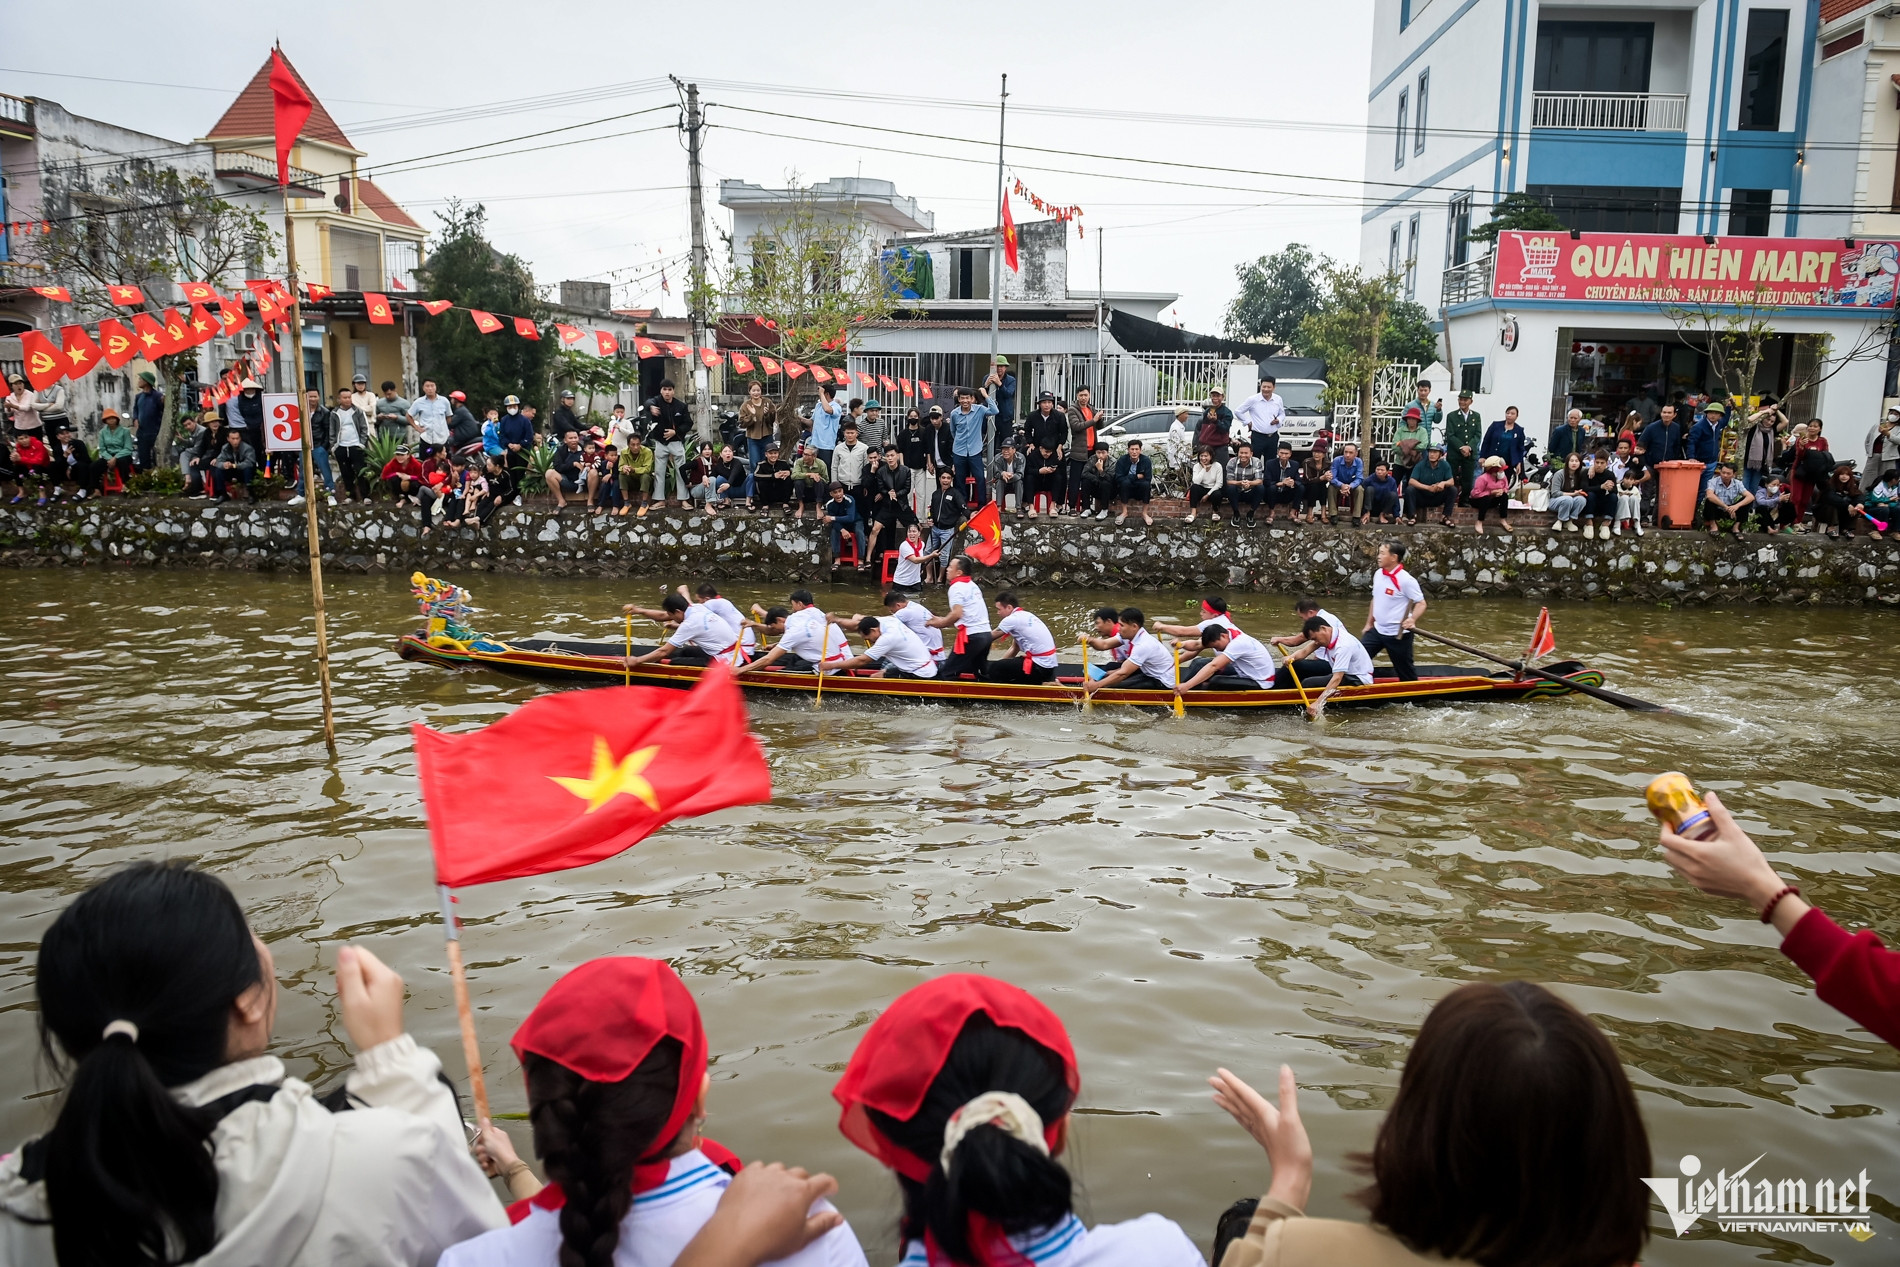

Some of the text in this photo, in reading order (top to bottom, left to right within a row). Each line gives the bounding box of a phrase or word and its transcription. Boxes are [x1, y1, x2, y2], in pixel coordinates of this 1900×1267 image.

[1570, 238, 1838, 284] QUÂN HIỀN MART
[1585, 283, 1627, 299] CHUYÊN
[1628, 284, 1650, 300] BÁN
[1651, 284, 1681, 301] BUÔN
[1687, 285, 1709, 301] BÁN
[1725, 286, 1755, 303] HÀNG
[1756, 287, 1781, 304] TIÊU
[1782, 288, 1812, 305] DÙNG
[272, 403, 302, 442] 3
